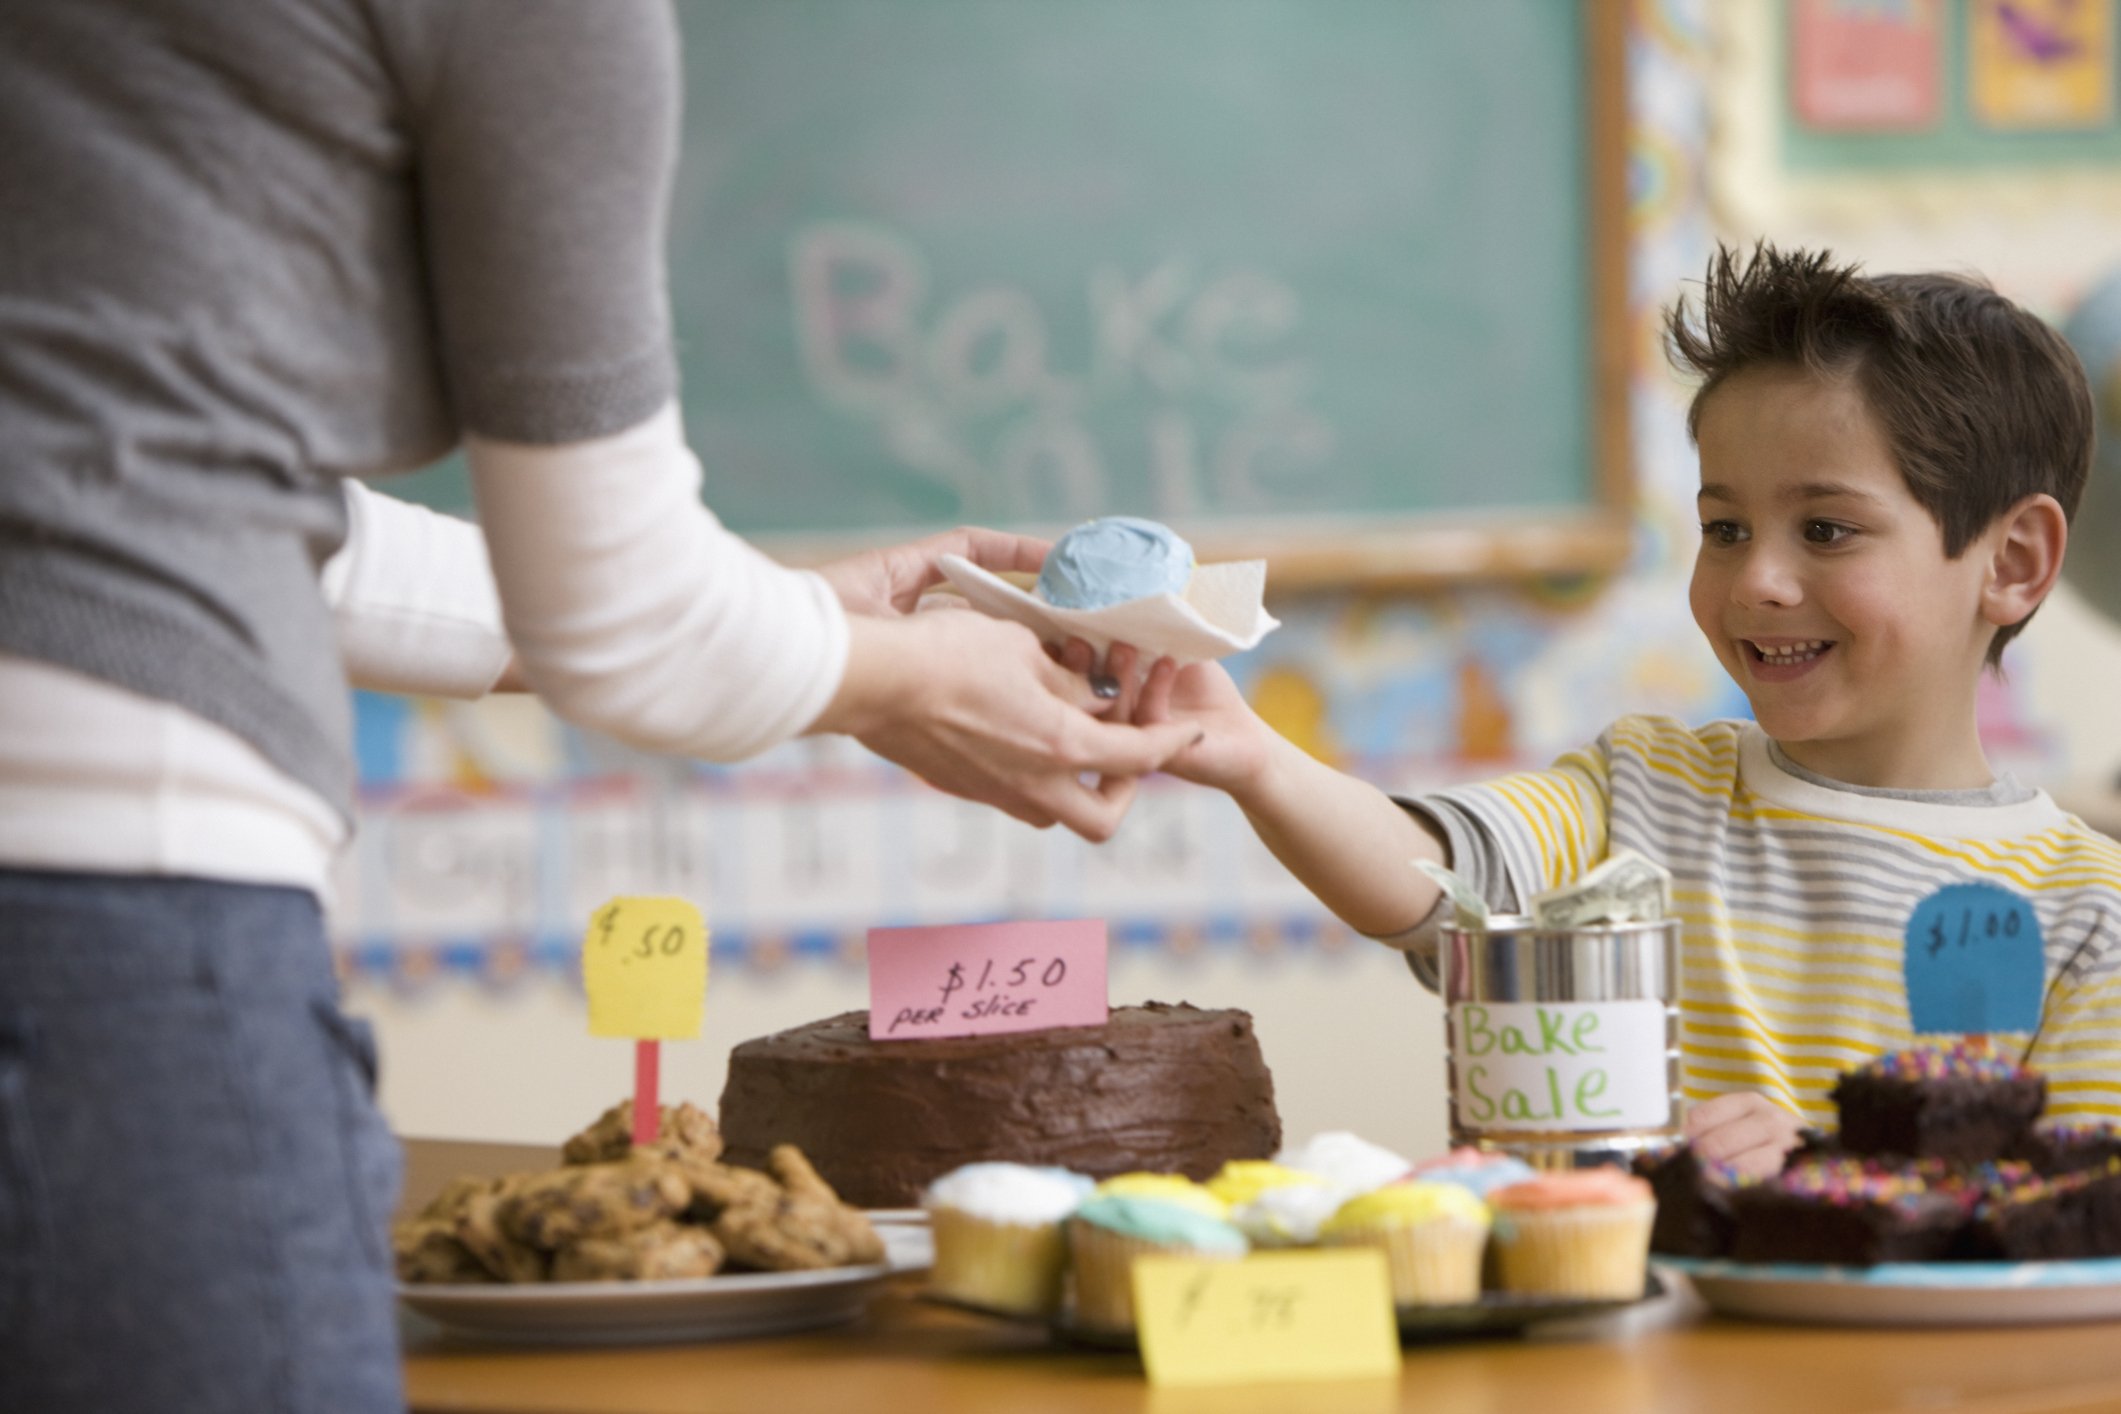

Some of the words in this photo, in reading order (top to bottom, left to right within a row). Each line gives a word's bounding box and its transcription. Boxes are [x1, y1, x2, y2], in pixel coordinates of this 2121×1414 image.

[938, 957, 1067, 1004] $1.50
[1463, 1006, 1606, 1056] Bake
[1467, 1065, 1623, 1121] Sale
